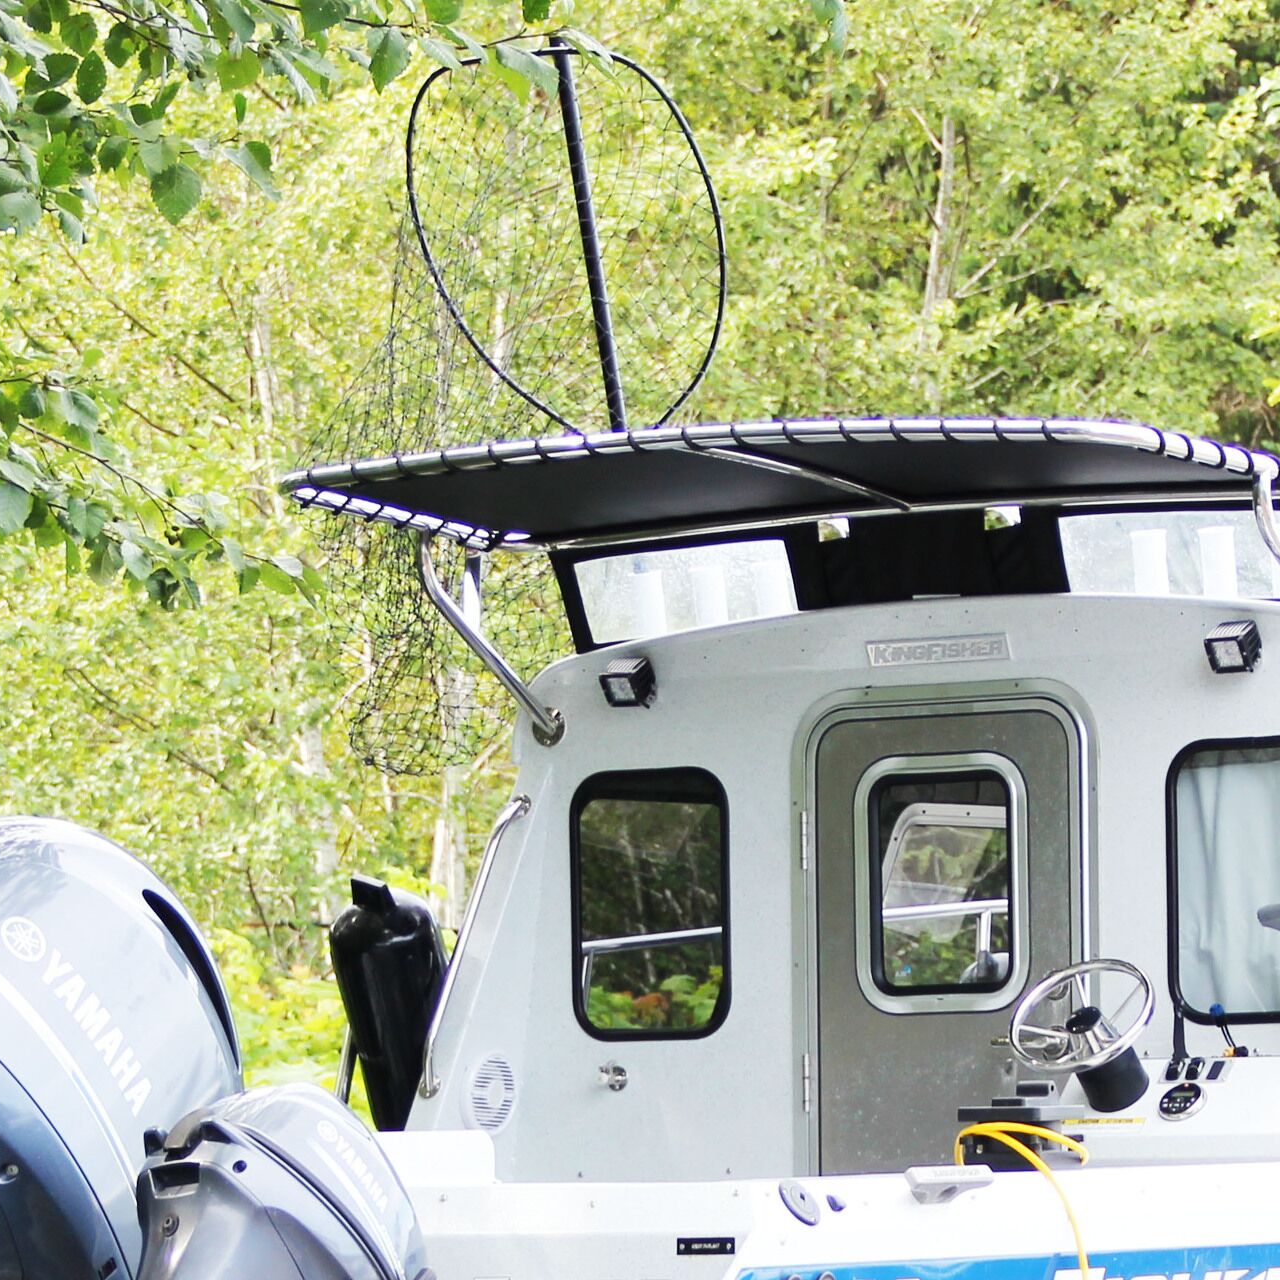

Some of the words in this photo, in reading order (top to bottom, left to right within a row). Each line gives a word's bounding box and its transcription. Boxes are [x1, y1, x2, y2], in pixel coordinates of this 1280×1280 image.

[873, 640, 1002, 665] KINGFISHER
[41, 949, 152, 1118] YAMAHA
[335, 1135, 388, 1214] YAMAHA
